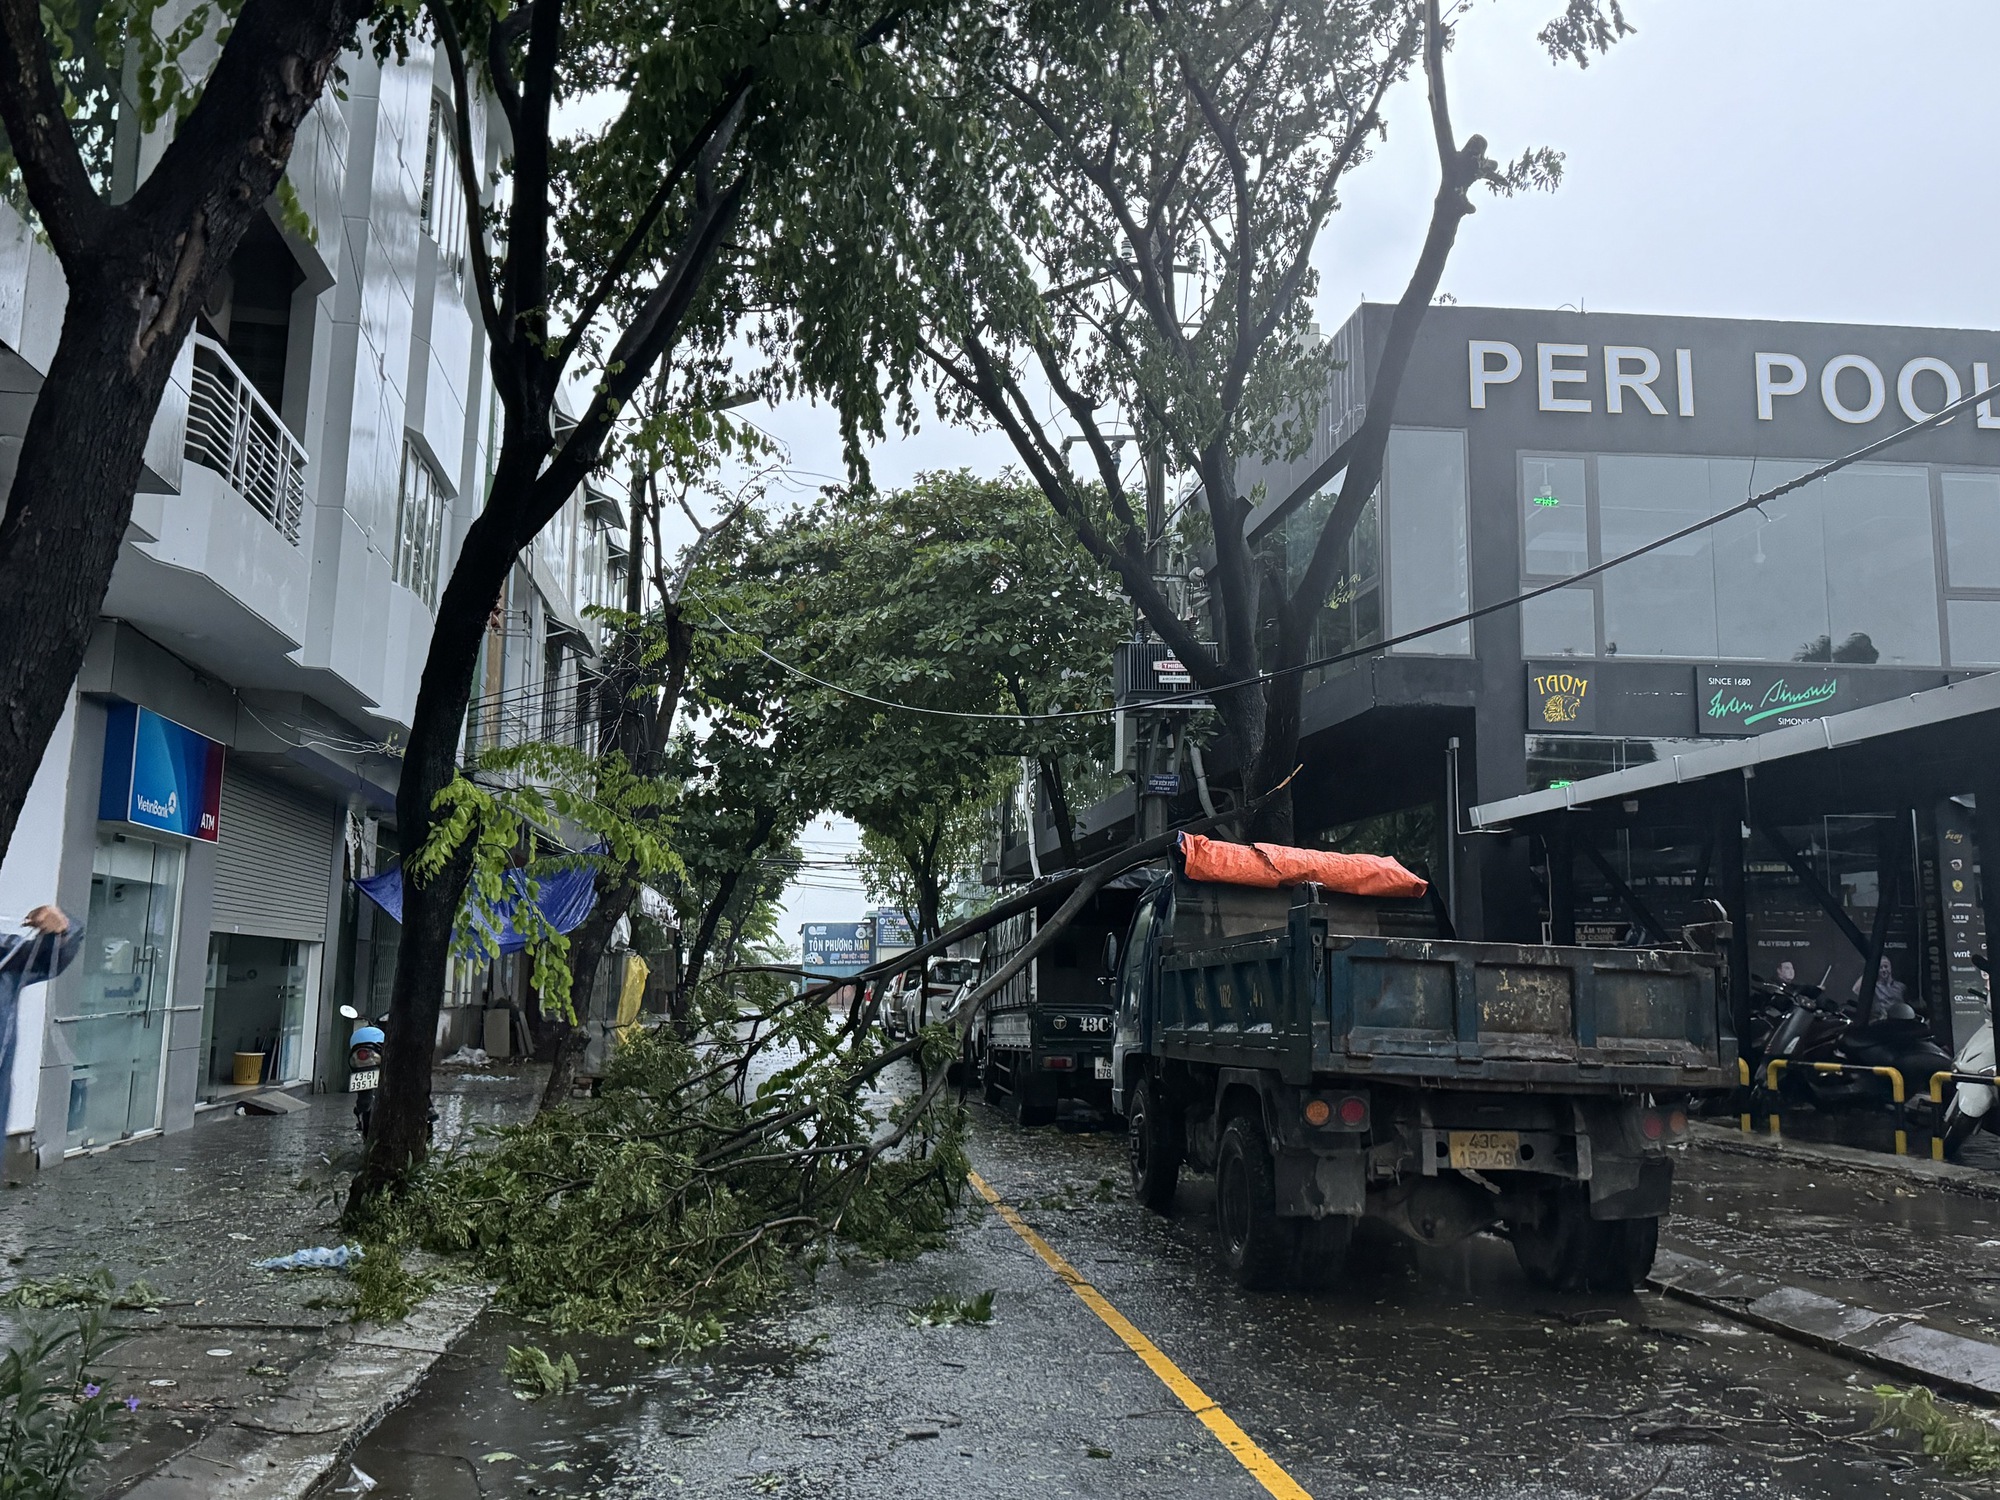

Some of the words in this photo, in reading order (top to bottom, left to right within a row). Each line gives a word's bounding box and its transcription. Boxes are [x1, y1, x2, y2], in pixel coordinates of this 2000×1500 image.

[1468, 340, 1695, 417] PERI
[1754, 351, 2000, 429] POOL
[1533, 674, 1589, 697] TAOM
[1708, 677, 1732, 686] SINCE
[1734, 678, 1752, 686] 1680
[1760, 678, 1837, 708] Simonis
[137, 794, 169, 818] VietinBank
[200, 812, 215, 831] ATM
[808, 937, 824, 952] TÔN
[825, 938, 853, 952] PHƯƠNG
[854, 939, 870, 951] NAM
[1954, 950, 1971, 958] wnt
[355, 1072, 375, 1081] 43-G1
[1469, 1133, 1499, 1148] 43C
